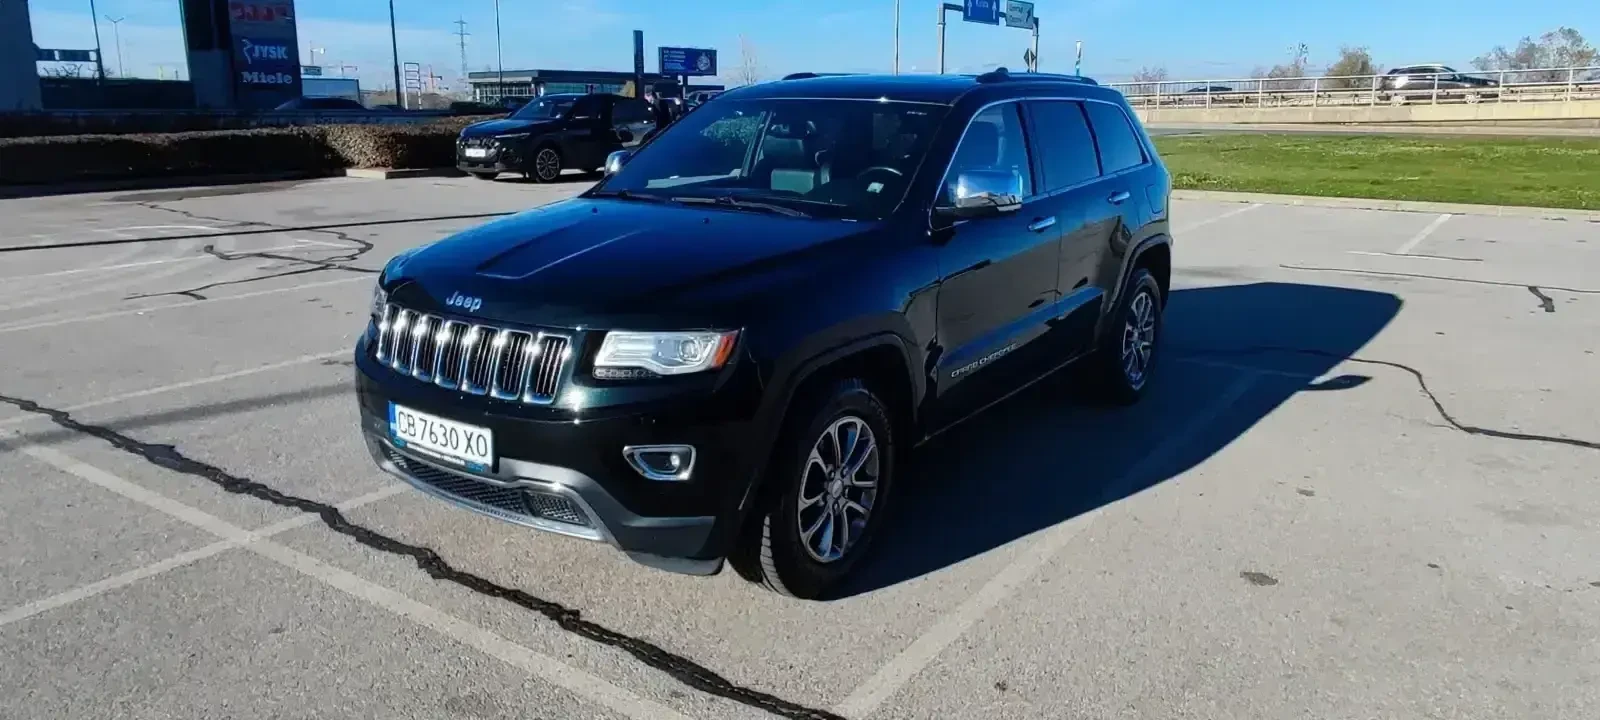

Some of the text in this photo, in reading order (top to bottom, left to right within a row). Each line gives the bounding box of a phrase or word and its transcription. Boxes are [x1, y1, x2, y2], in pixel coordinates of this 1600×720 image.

[252, 45, 288, 60] JYSK
[241, 71, 293, 85] Miele
[445, 290, 482, 313] Jeep
